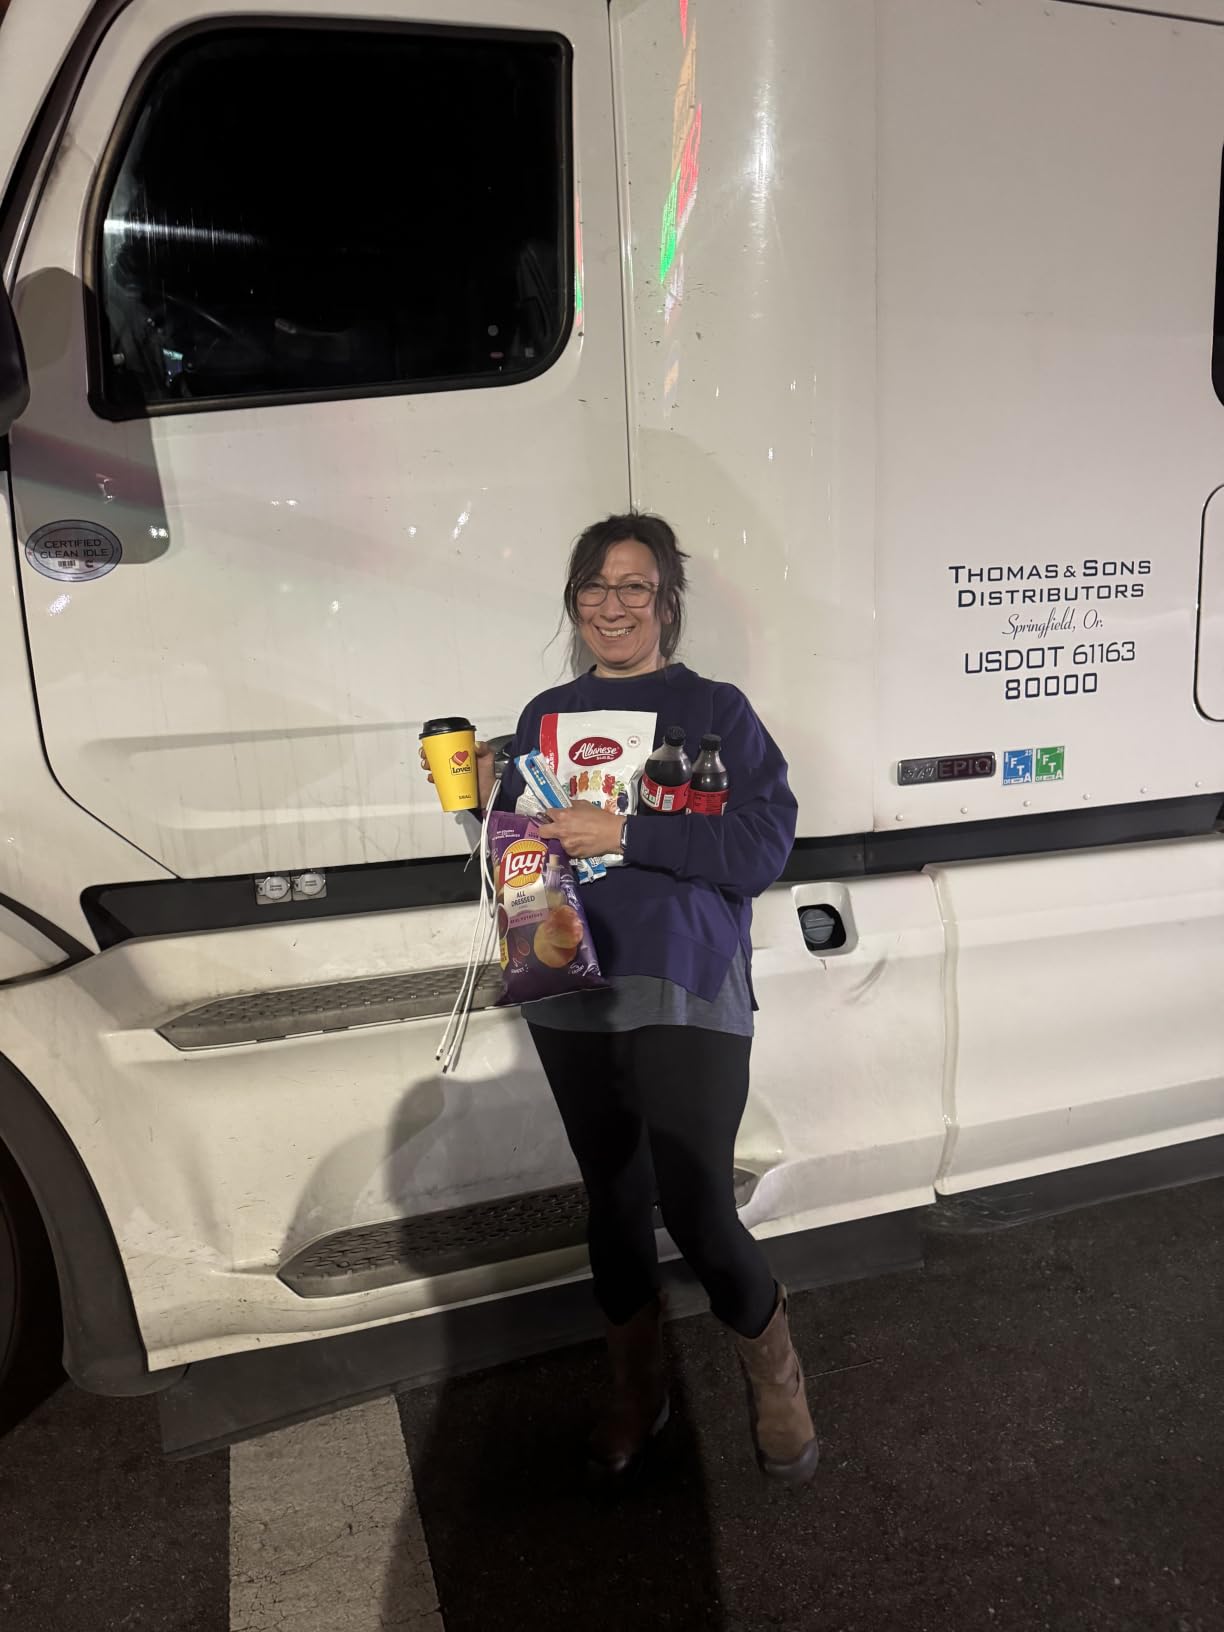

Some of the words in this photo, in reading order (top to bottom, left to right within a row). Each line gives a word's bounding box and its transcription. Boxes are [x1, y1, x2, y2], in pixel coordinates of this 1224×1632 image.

[43, 538, 102, 549] CERTIFIED
[40, 550, 78, 559] CLEAN
[83, 548, 109, 557] IDLE
[949, 564, 1059, 584] THOMAS
[1063, 565, 1077, 578] &
[1083, 559, 1152, 578] SONS
[957, 583, 1145, 608] DISTRIBUTORS
[1001, 606, 1076, 640] Springfield,
[1083, 608, 1104, 630] Or.
[964, 645, 1065, 674] USDOT
[1072, 640, 1136, 665] 61163
[1004, 672, 1098, 700] 80000
[573, 742, 619, 760] Albanese
[452, 764, 471, 774] Love's
[939, 757, 991, 778] EPIQ
[511, 895, 536, 907] DRESSED
[516, 890, 526, 898] ALL
